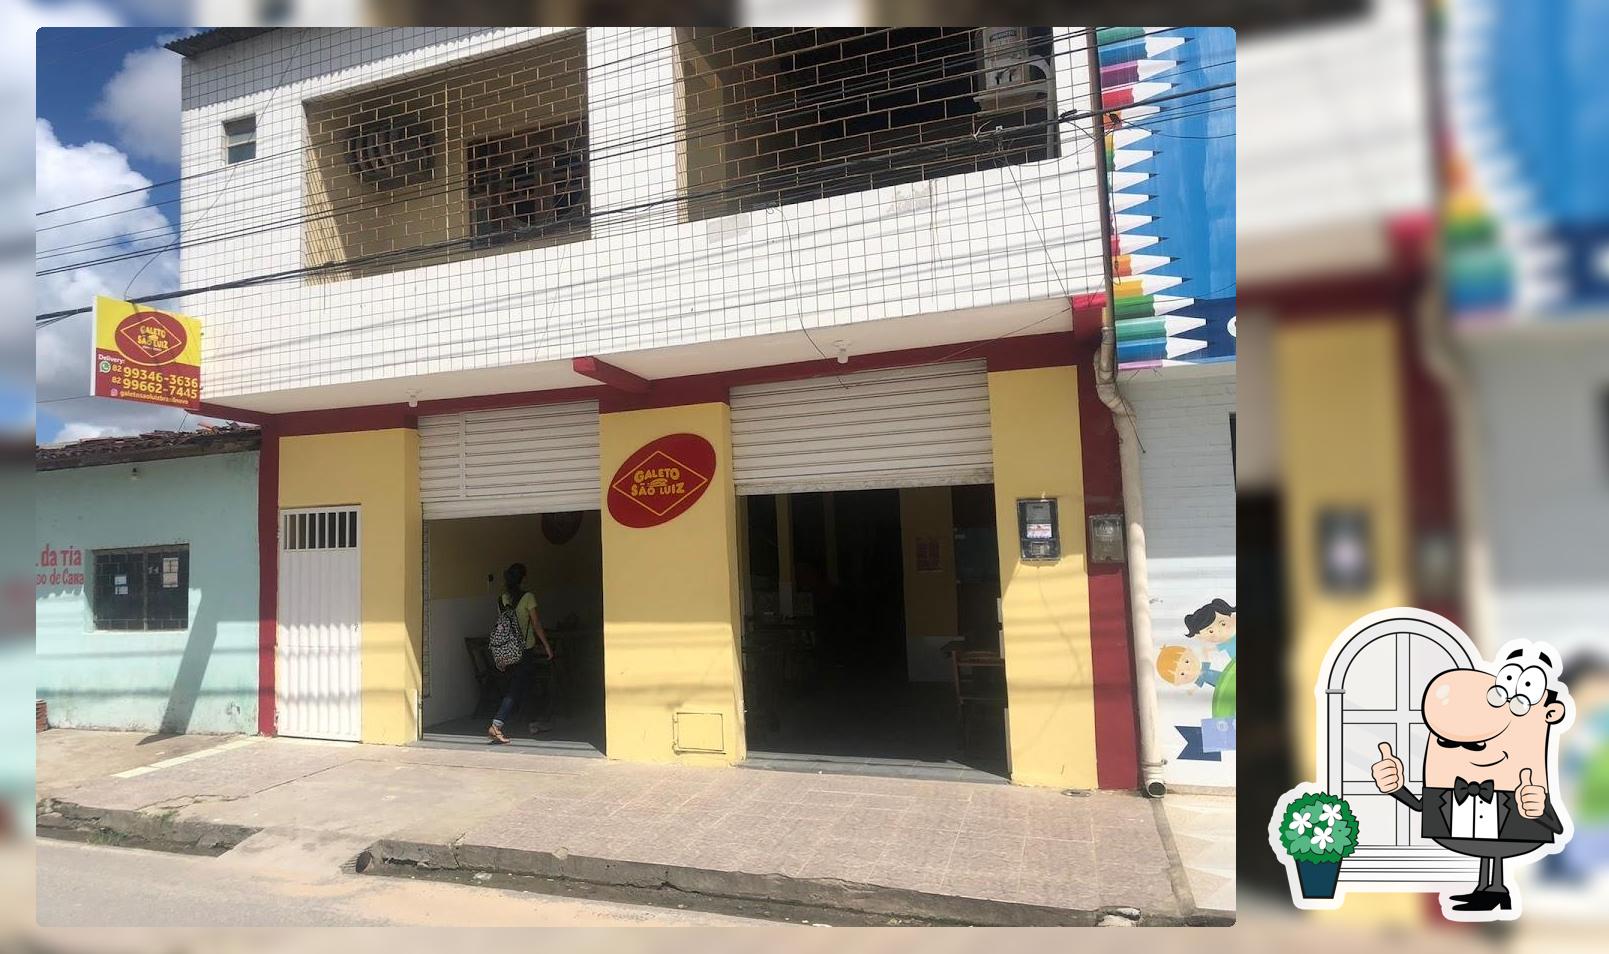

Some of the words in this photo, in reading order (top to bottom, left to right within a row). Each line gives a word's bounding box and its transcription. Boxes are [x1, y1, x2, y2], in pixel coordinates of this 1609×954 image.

[140, 325, 166, 339] GALETO
[153, 340, 169, 350] LUIZ
[98, 353, 125, 364] Delivery:
[112, 365, 122, 373] 82
[123, 366, 198, 388] 99346-3636
[112, 376, 121, 384] 82
[123, 378, 198, 399] 99662-7445
[633, 467, 681, 483] GALETO
[631, 482, 656, 496] SÃO
[659, 482, 685, 495] LUIZ
[41, 544, 57, 567] da
[50, 568, 60, 585] de
